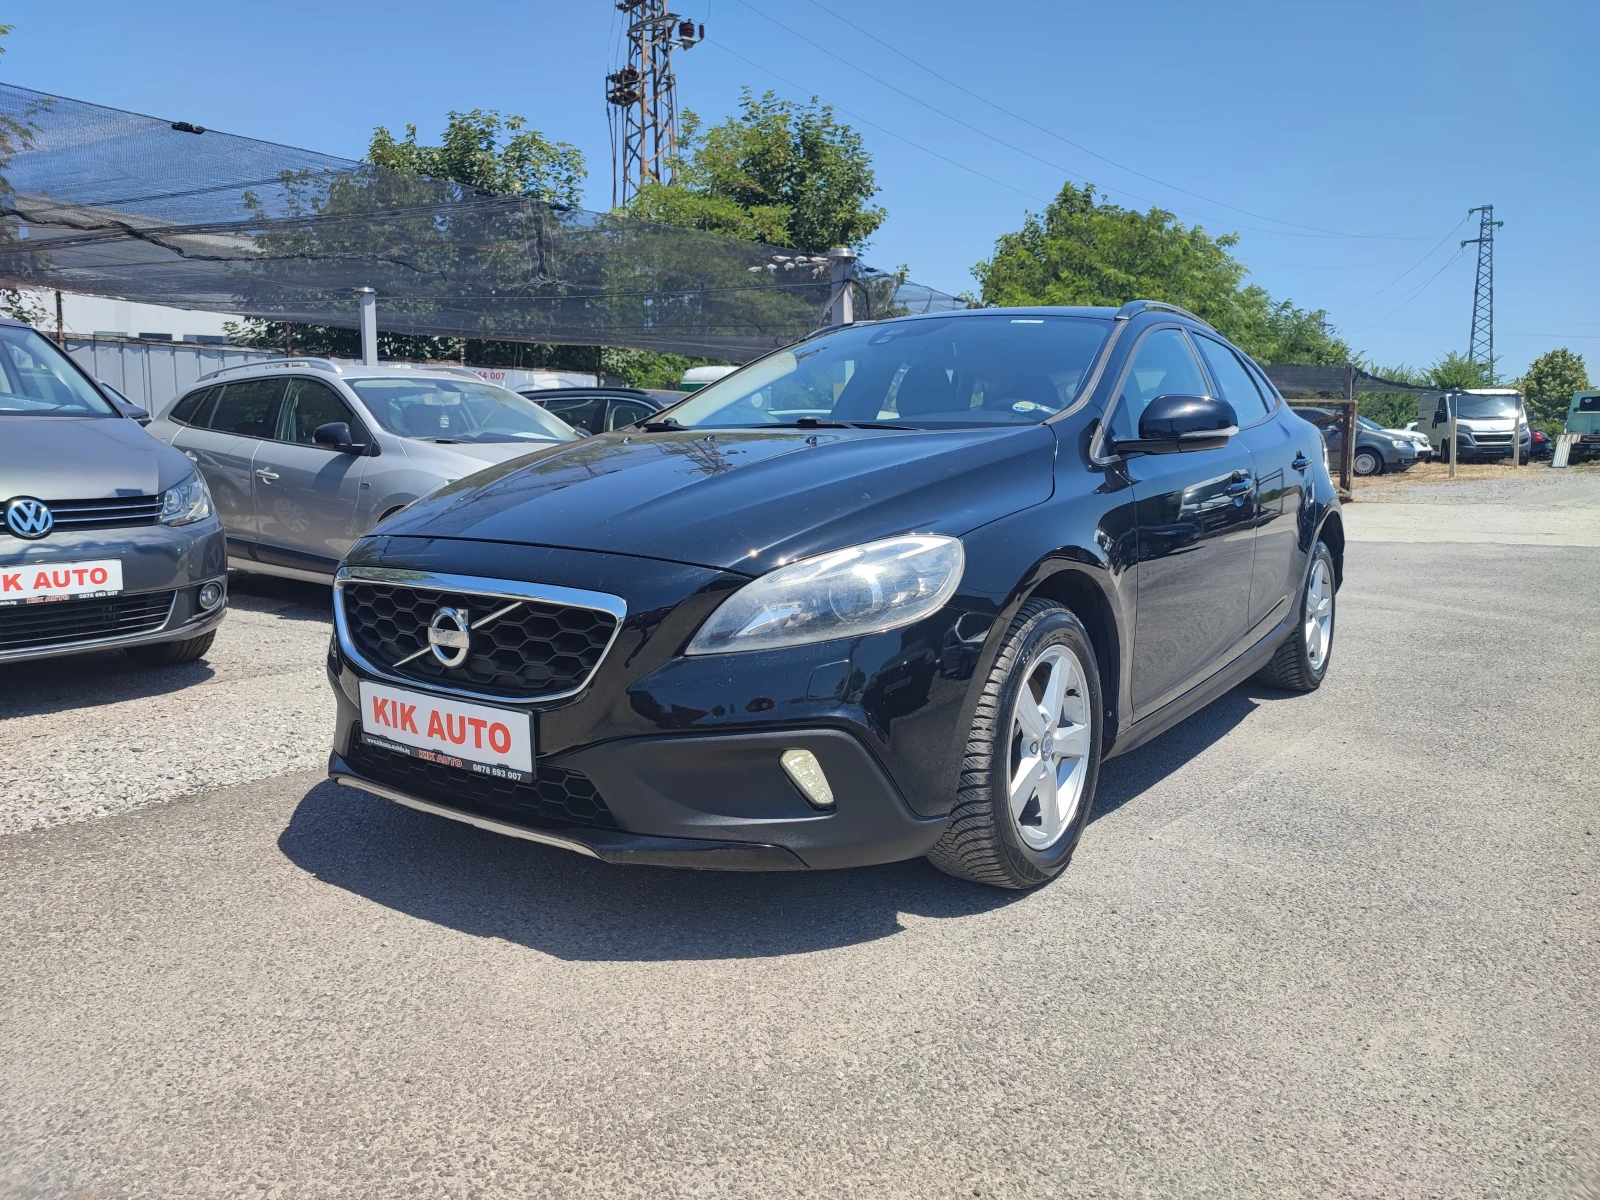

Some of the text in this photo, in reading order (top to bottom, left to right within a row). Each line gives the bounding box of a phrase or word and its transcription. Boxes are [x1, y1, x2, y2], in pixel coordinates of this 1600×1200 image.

[490, 372, 505, 380] 007
[33, 567, 108, 590] AUTO
[26, 596, 44, 604] KIK
[45, 594, 70, 602] AUTO
[372, 695, 512, 754] KIK AUTO
[418, 749, 436, 762] KIK
[436, 754, 463, 768] AUTO
[472, 763, 490, 774] 0878
[492, 767, 506, 778] 693
[507, 771, 522, 781] 007
